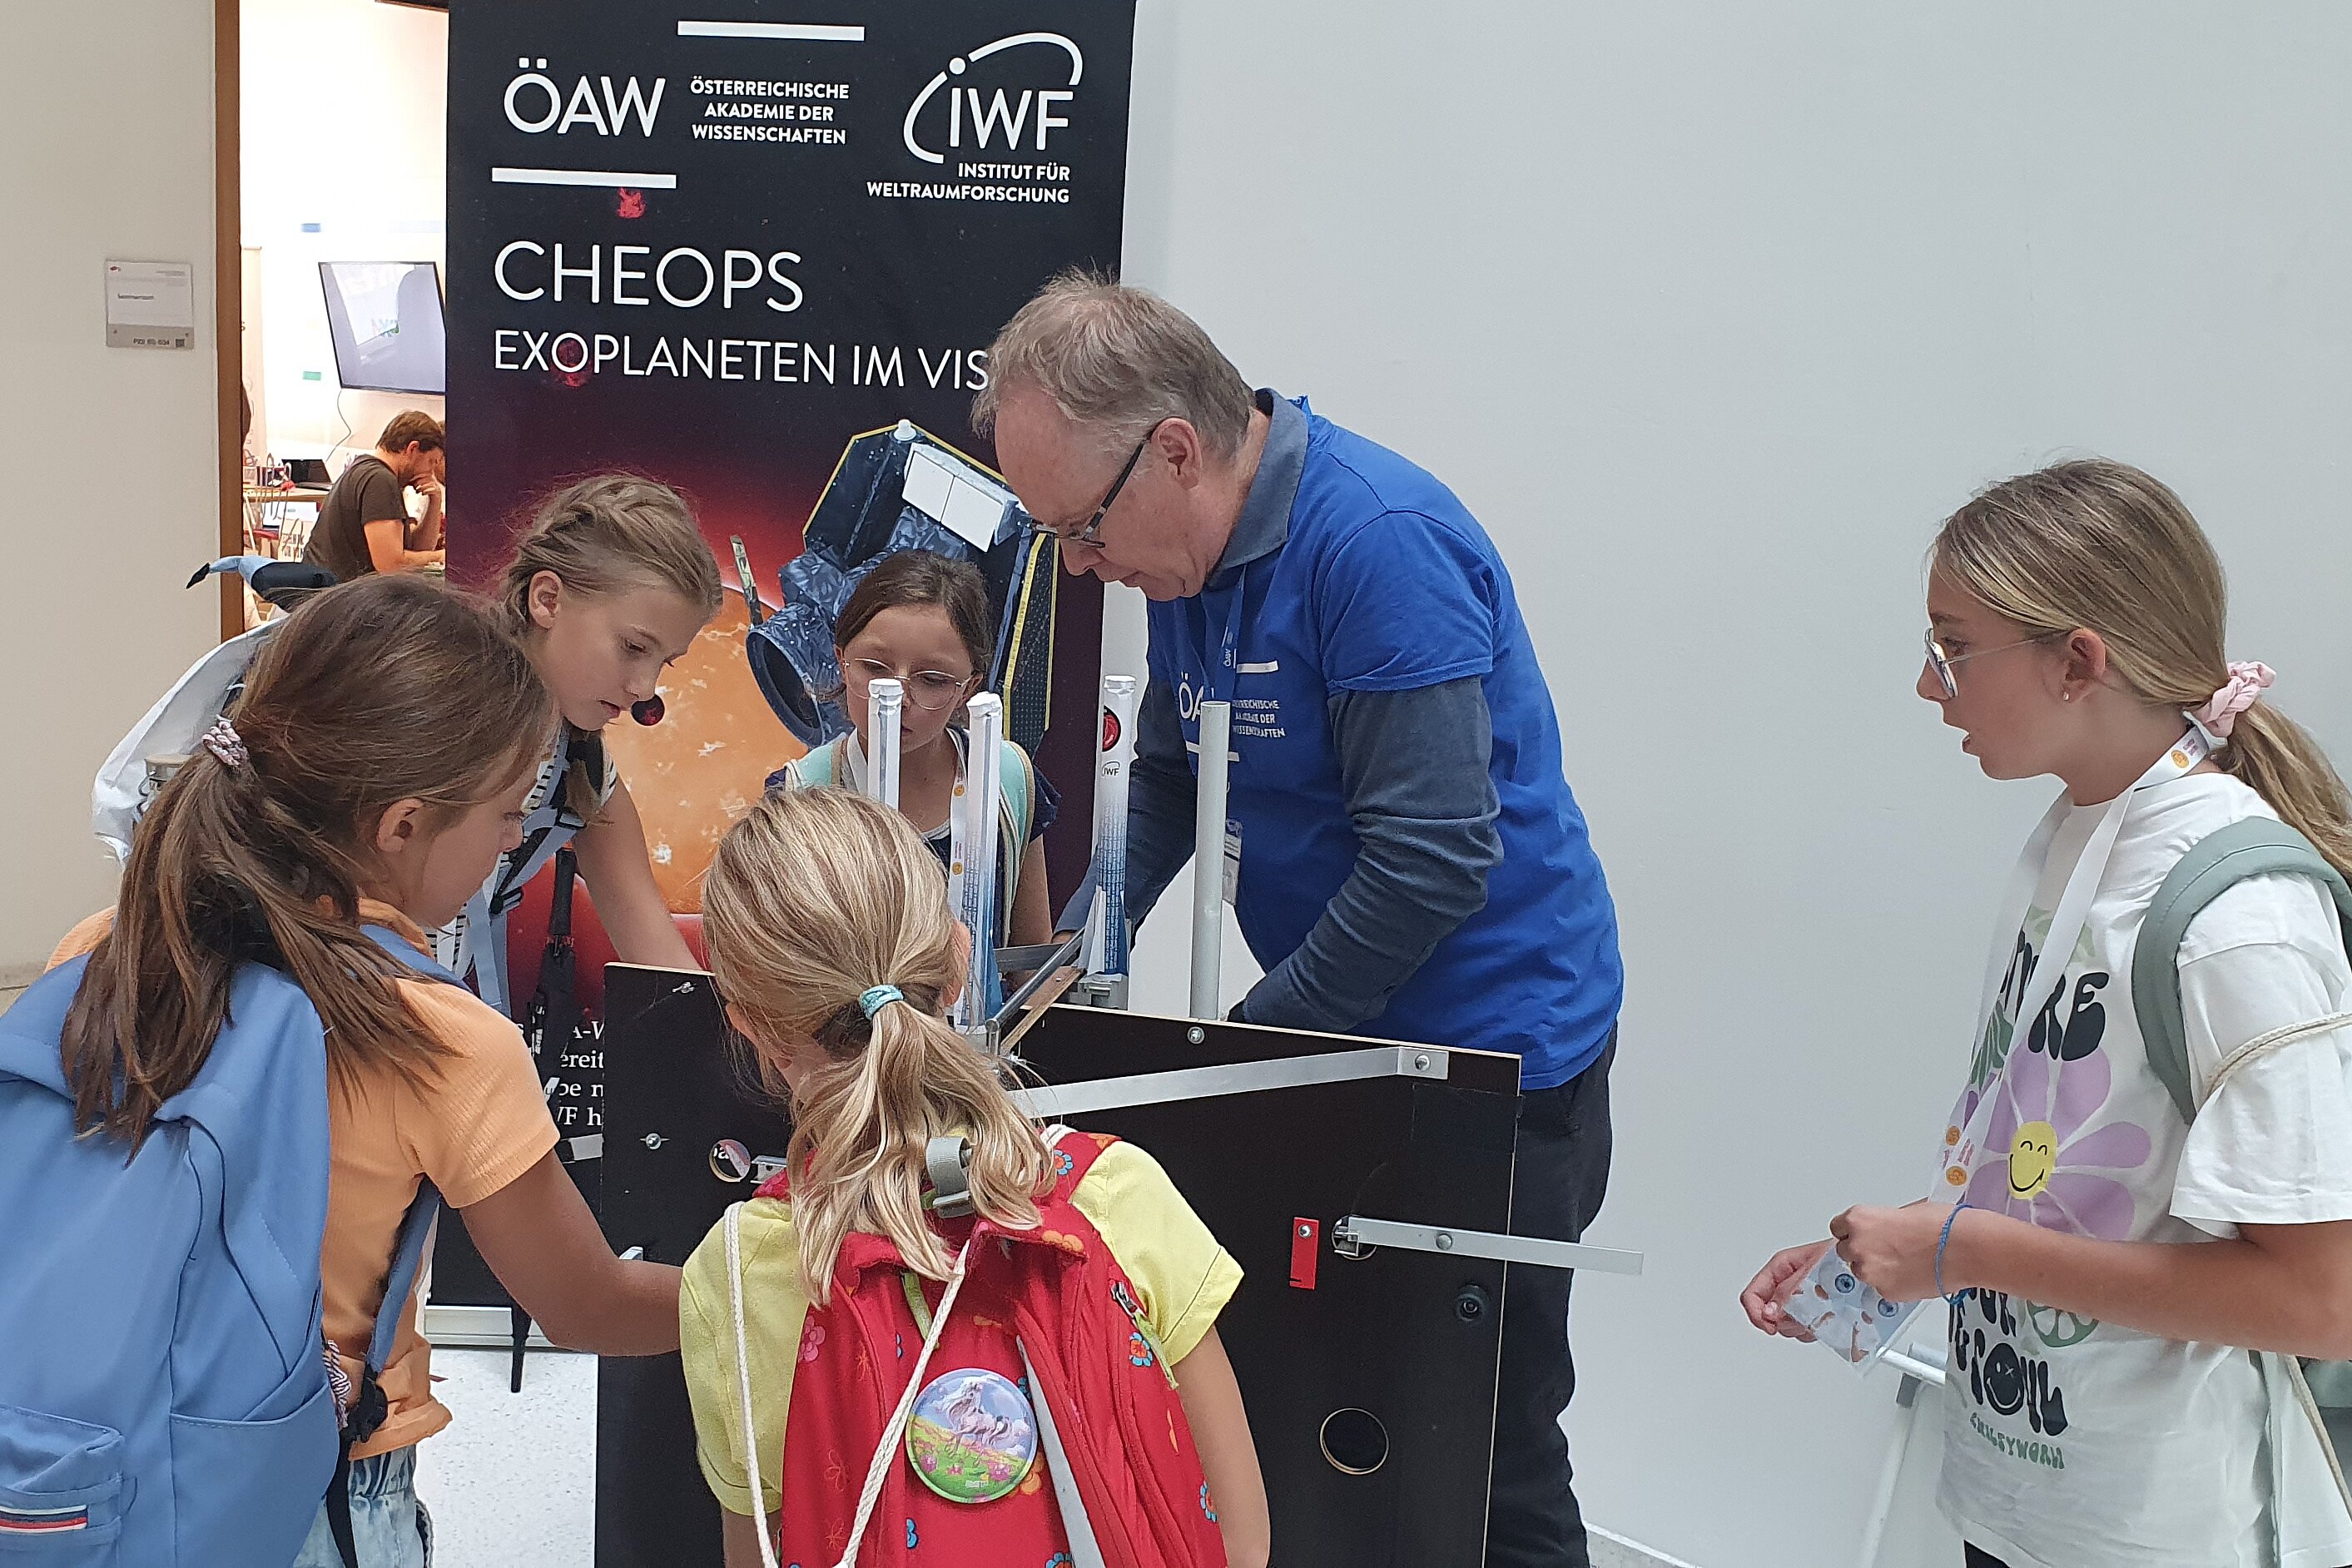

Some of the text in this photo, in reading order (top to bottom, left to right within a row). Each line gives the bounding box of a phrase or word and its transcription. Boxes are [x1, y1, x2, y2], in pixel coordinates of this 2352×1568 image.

[504, 57, 667, 137] ÖAW
[690, 76, 850, 99] ÖSTERREICHISCHE
[704, 102, 834, 122] AKADEMIE DER
[692, 124, 846, 145] WISSENSCHAFTEN
[958, 162, 1070, 181] INSTITUT FÜR
[866, 181, 1069, 203] WELTRAUMFORSCHUNG
[494, 241, 803, 312] CHEOPS
[494, 330, 990, 391] EXOPLANETEN IM VIS
[1259, 713, 1275, 724] DER
